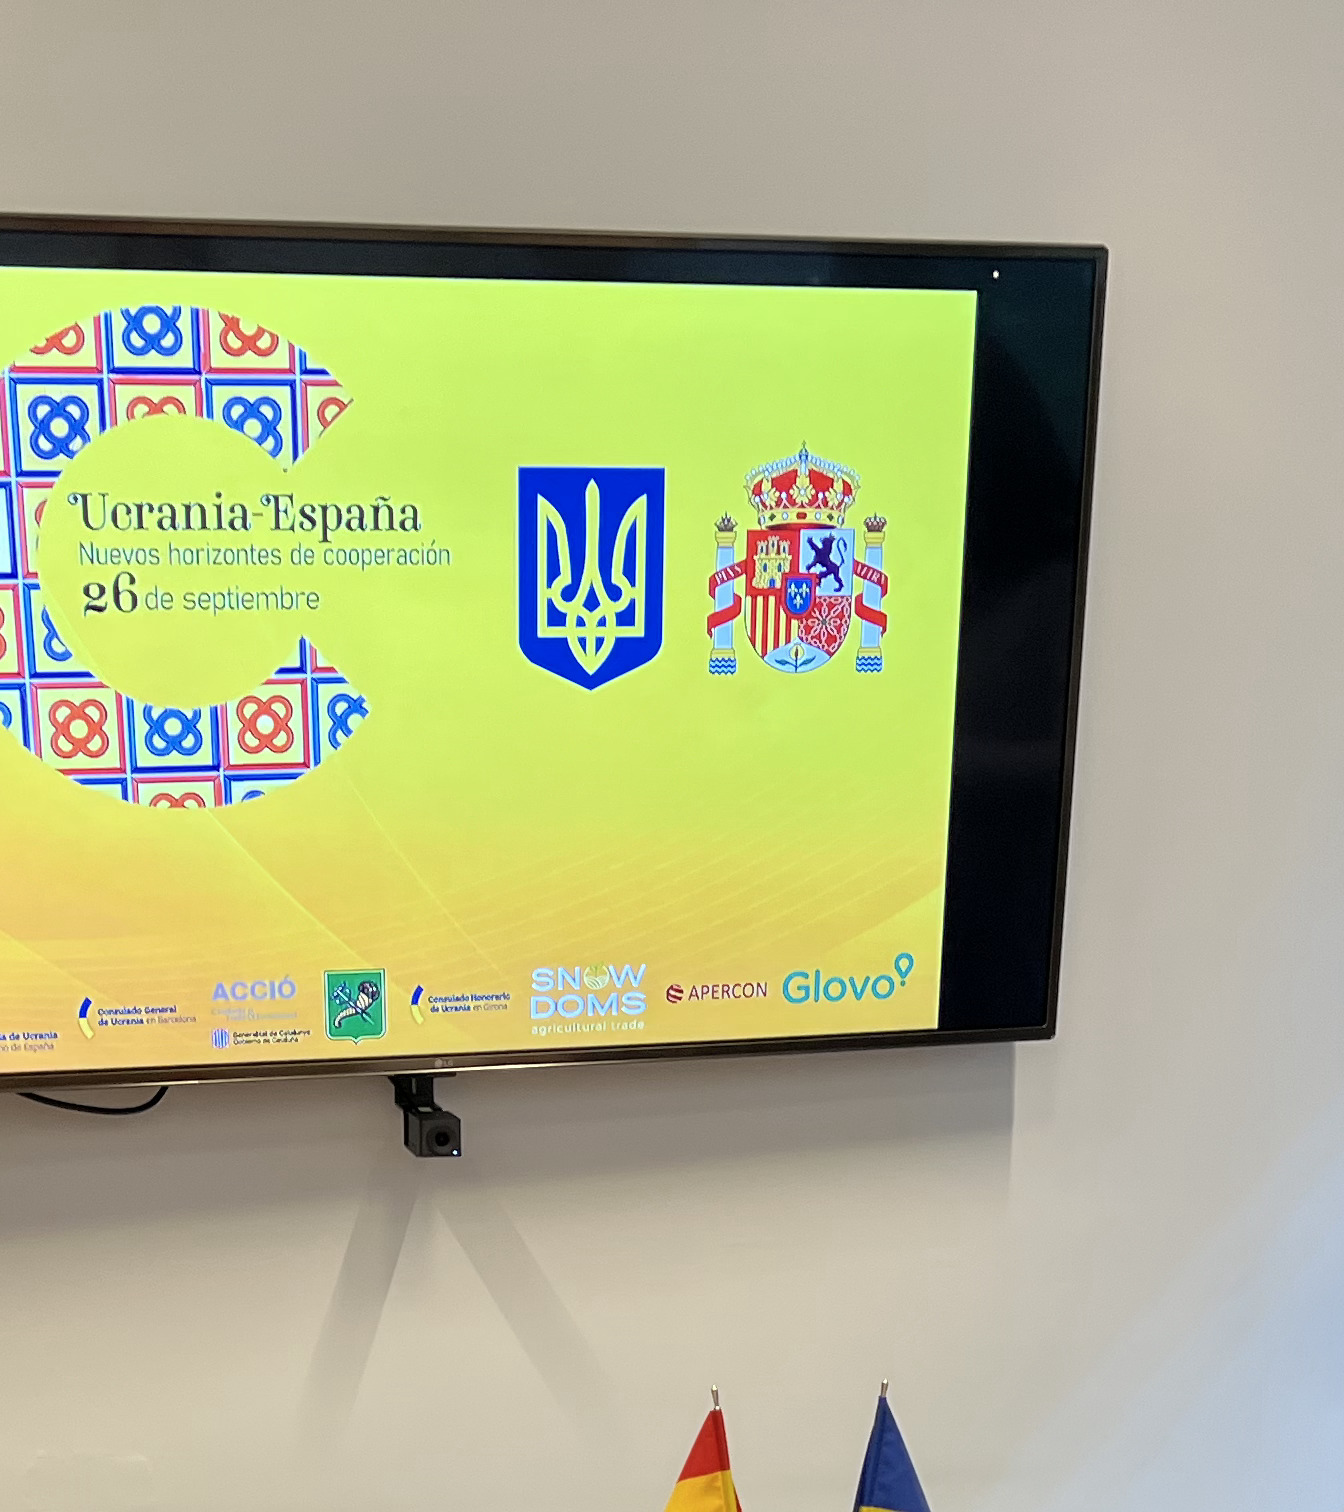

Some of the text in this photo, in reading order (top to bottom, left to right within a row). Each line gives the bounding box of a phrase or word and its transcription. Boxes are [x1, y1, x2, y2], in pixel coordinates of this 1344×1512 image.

[79, 538, 451, 572] Nuevos horizontes de cooperación
[82, 571, 320, 617] 26 de septiembre
[212, 974, 296, 1001] ACCIÓ
[688, 981, 768, 1001] APERCON
[782, 968, 895, 1004] Glovo
[144, 1005, 177, 1014] General
[530, 991, 648, 1019] DOMS
[111, 1016, 144, 1026] Ucrania
[531, 1018, 645, 1036] agricultural trade
[9, 1032, 20, 1041] de
[22, 1030, 58, 1041] Ucrania
